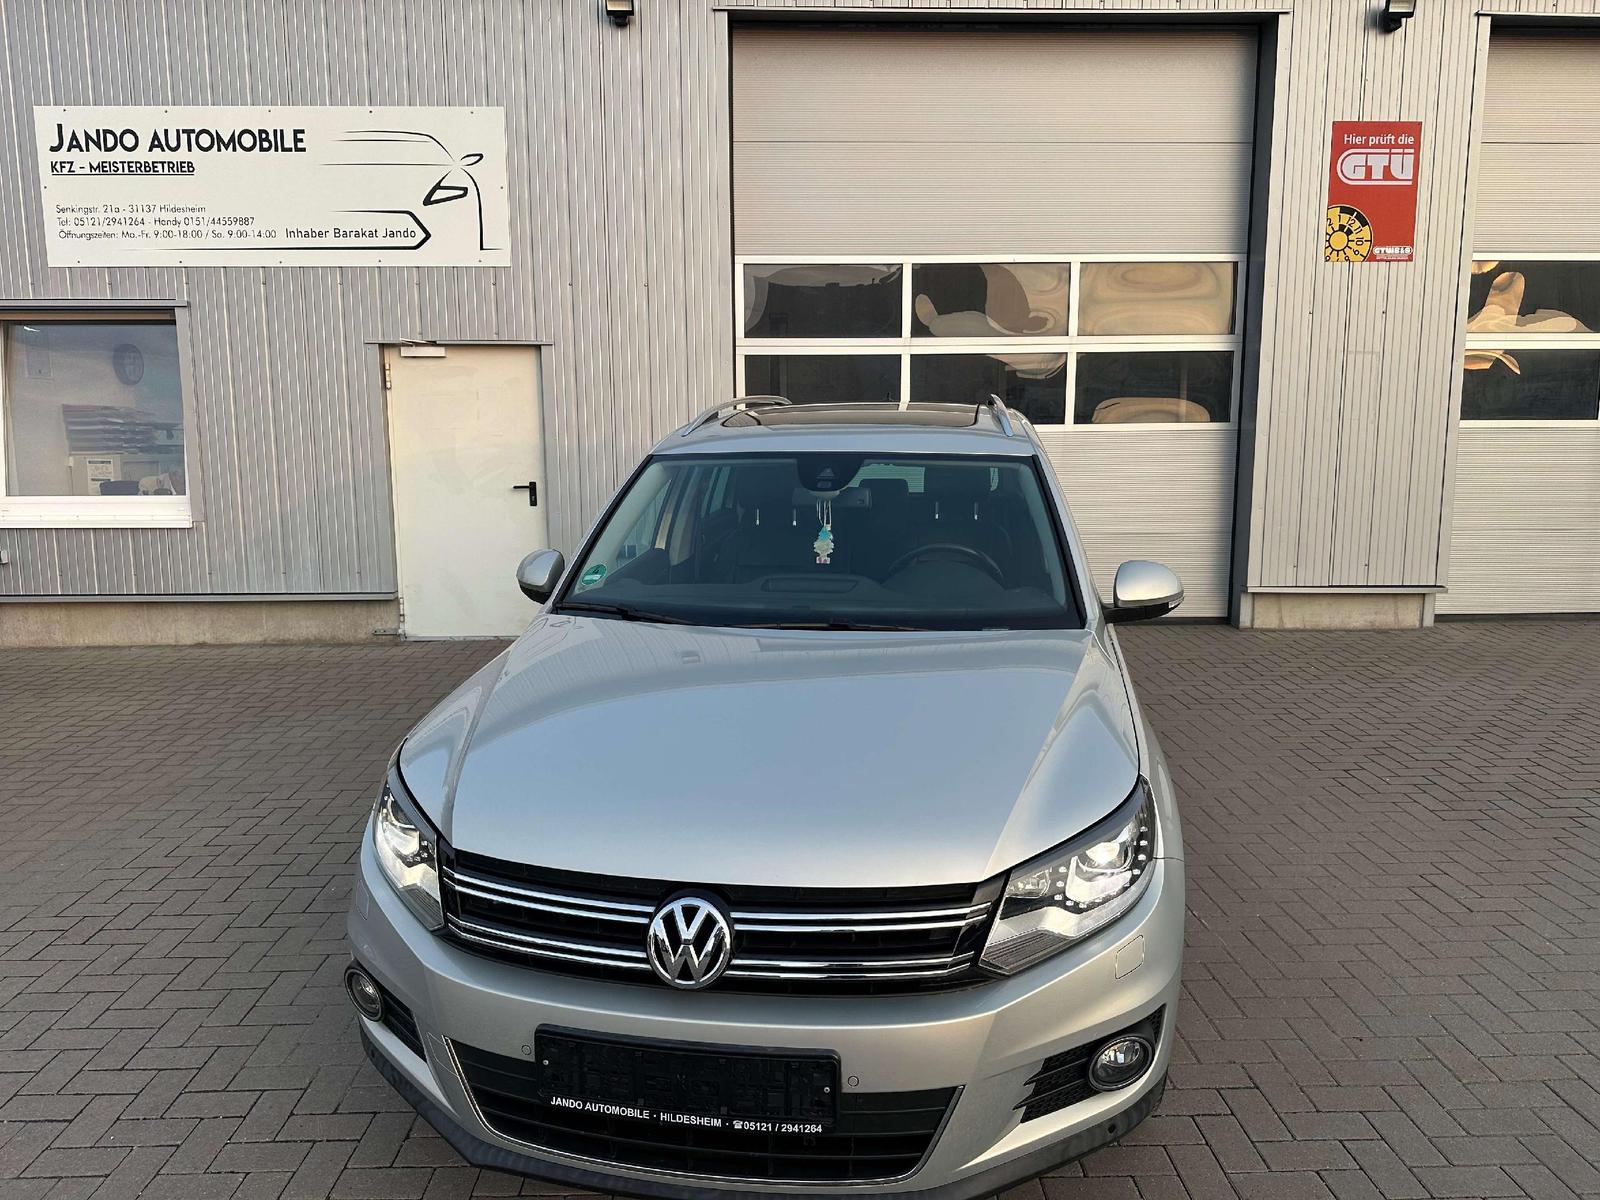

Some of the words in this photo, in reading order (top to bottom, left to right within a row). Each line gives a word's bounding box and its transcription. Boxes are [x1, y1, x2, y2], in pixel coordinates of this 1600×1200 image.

[50, 123, 139, 152] JANDO
[150, 128, 307, 152] AUTOMOBILE
[1344, 134, 1366, 145] Hier
[1369, 134, 1395, 147] prüft
[1398, 134, 1414, 145] die
[50, 161, 76, 173] KFZ
[89, 160, 195, 173] MEISTERBETRIEB
[1337, 148, 1414, 185] GTÜ
[103, 204, 120, 213] 21a
[128, 204, 157, 213] 31137
[160, 204, 206, 213] Hildesheim
[74, 217, 145, 227] 05121/2941264
[154, 217, 181, 228] Handy
[184, 217, 255, 227] 0151/44559887
[59, 229, 118, 241] Öffnungszeiten:
[153, 230, 203, 239] 9:00-18:00
[227, 230, 277, 239] 9:00-14:00
[285, 228, 329, 238] Inhaber
[333, 228, 379, 238] Barakat
[382, 228, 416, 238] Jando
[1355, 237, 1364, 246] 10
[648, 898, 730, 988] VW
[550, 1096, 583, 1110] JANDO
[584, 1101, 650, 1120] AUTOMOBILE
[660, 1112, 722, 1127] HILDESHEIM
[781, 1123, 823, 1133] 2941264
